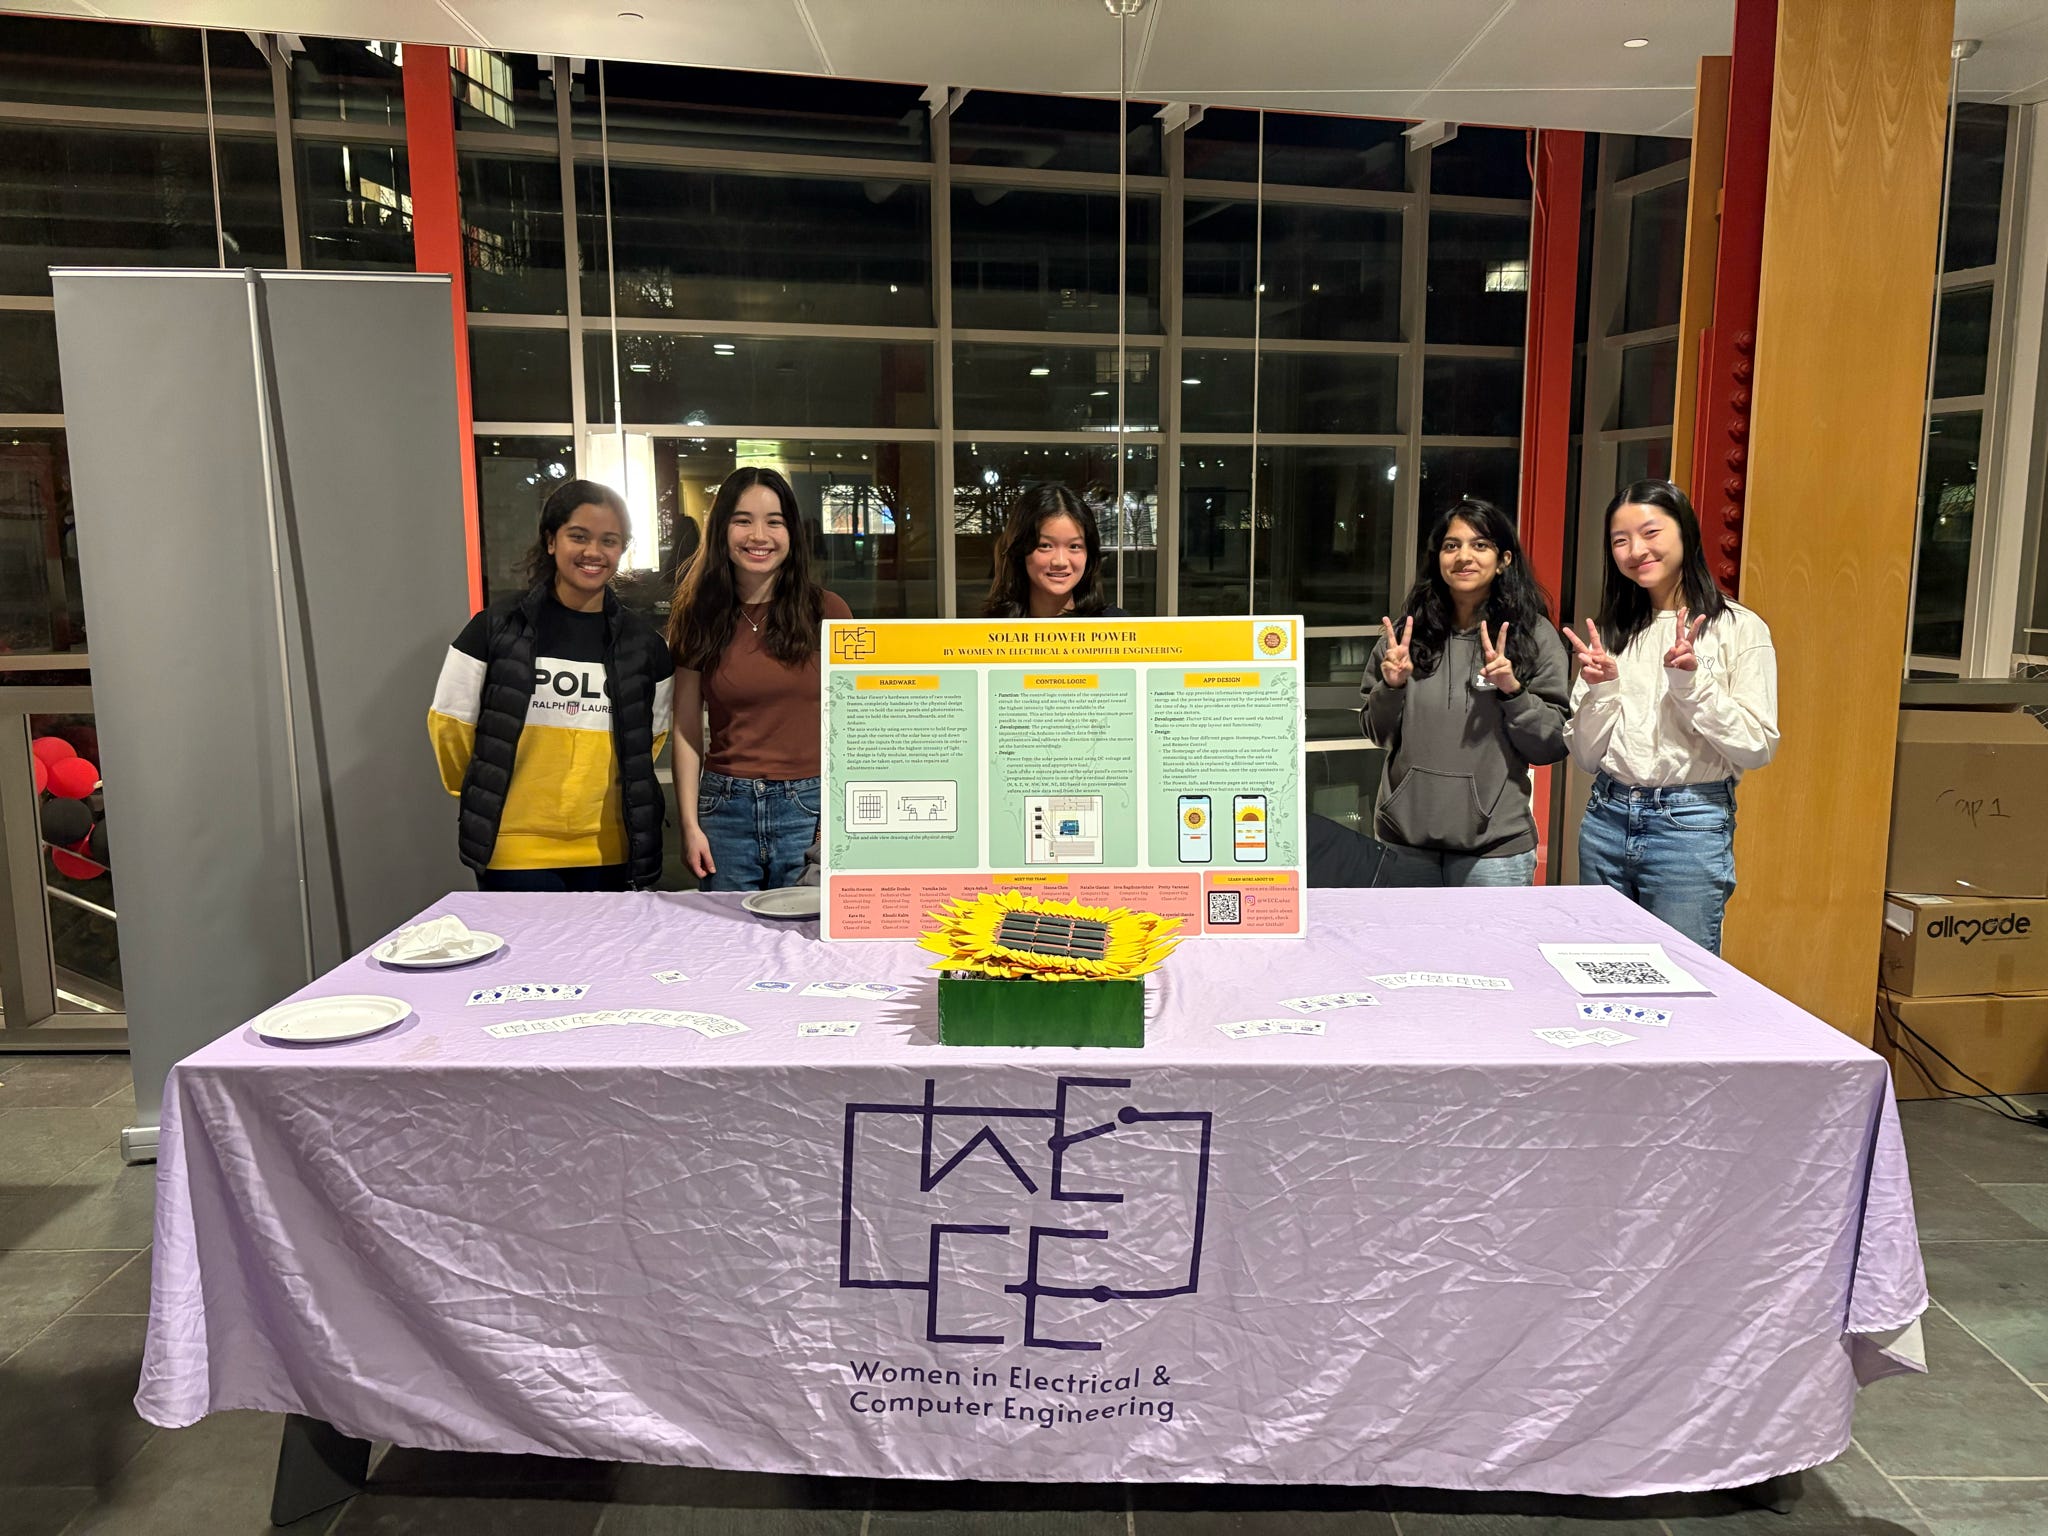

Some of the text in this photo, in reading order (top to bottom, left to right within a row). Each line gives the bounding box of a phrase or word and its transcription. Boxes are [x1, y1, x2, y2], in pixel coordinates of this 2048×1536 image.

[988, 631, 1136, 642] SOLAR FLOWER POWER
[943, 647, 956, 655] BY
[957, 647, 993, 655] WOMEN
[996, 647, 1006, 655] IN
[1008, 647, 1059, 655] ELECTRICAL
[1071, 646, 1120, 654] COMPUTER
[1122, 646, 1183, 654] ENGINEERING
[532, 700, 565, 710] RALPH
[850, 1360, 1171, 1394] Women in Electrical &
[850, 1391, 1174, 1428] Computer Engineering
